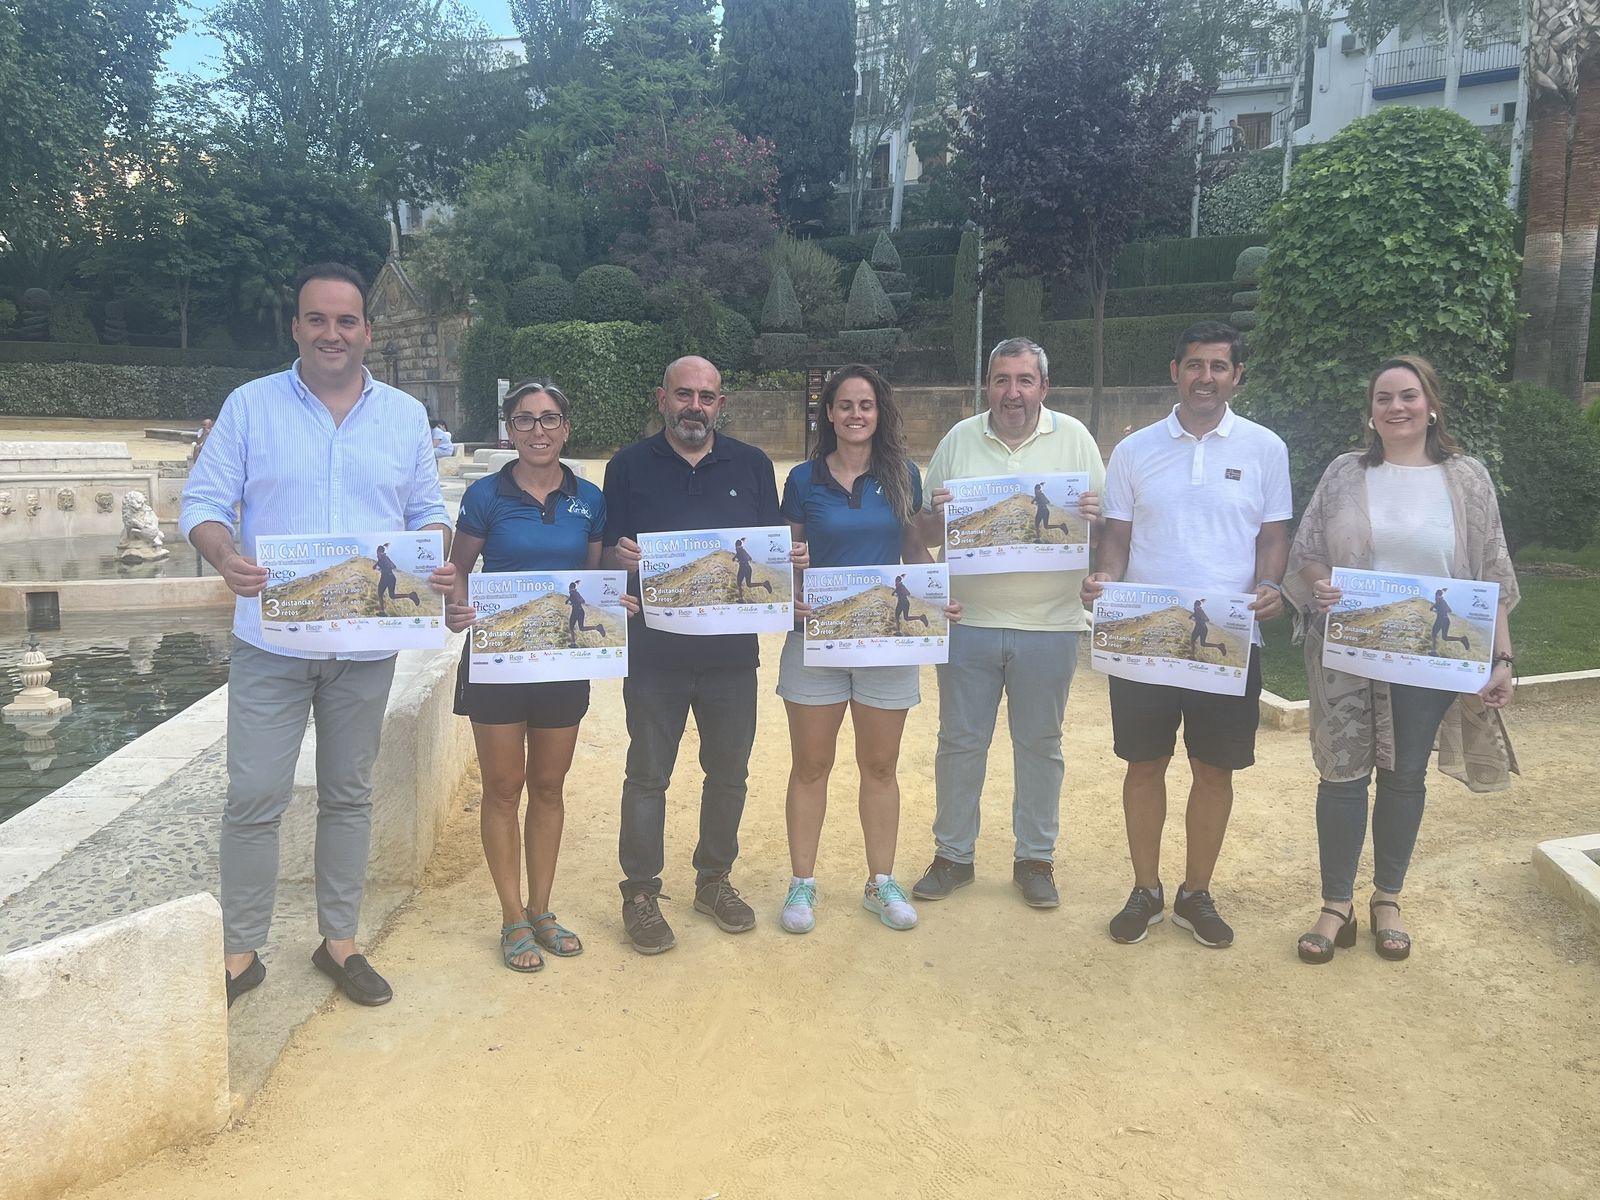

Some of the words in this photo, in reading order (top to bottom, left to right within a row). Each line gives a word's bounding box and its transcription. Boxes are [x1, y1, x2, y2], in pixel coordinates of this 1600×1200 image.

[959, 484, 983, 497] CxM
[641, 540, 653, 552] XI
[655, 539, 681, 552] CxM
[950, 529, 961, 546] 3
[261, 544, 275, 559] XI
[278, 543, 309, 558] CxM
[473, 580, 485, 593] XI
[488, 580, 513, 593] CxM
[807, 575, 818, 587] XI
[821, 574, 843, 586] CxM
[1335, 574, 1348, 588] XI
[1350, 576, 1377, 591] CxM
[646, 587, 659, 603] 3
[1112, 588, 1137, 603] CxM
[265, 598, 280, 617] 3
[809, 619, 820, 636] 3
[1330, 622, 1345, 640] 3
[476, 629, 489, 648] 3
[1096, 631, 1109, 647] 3
